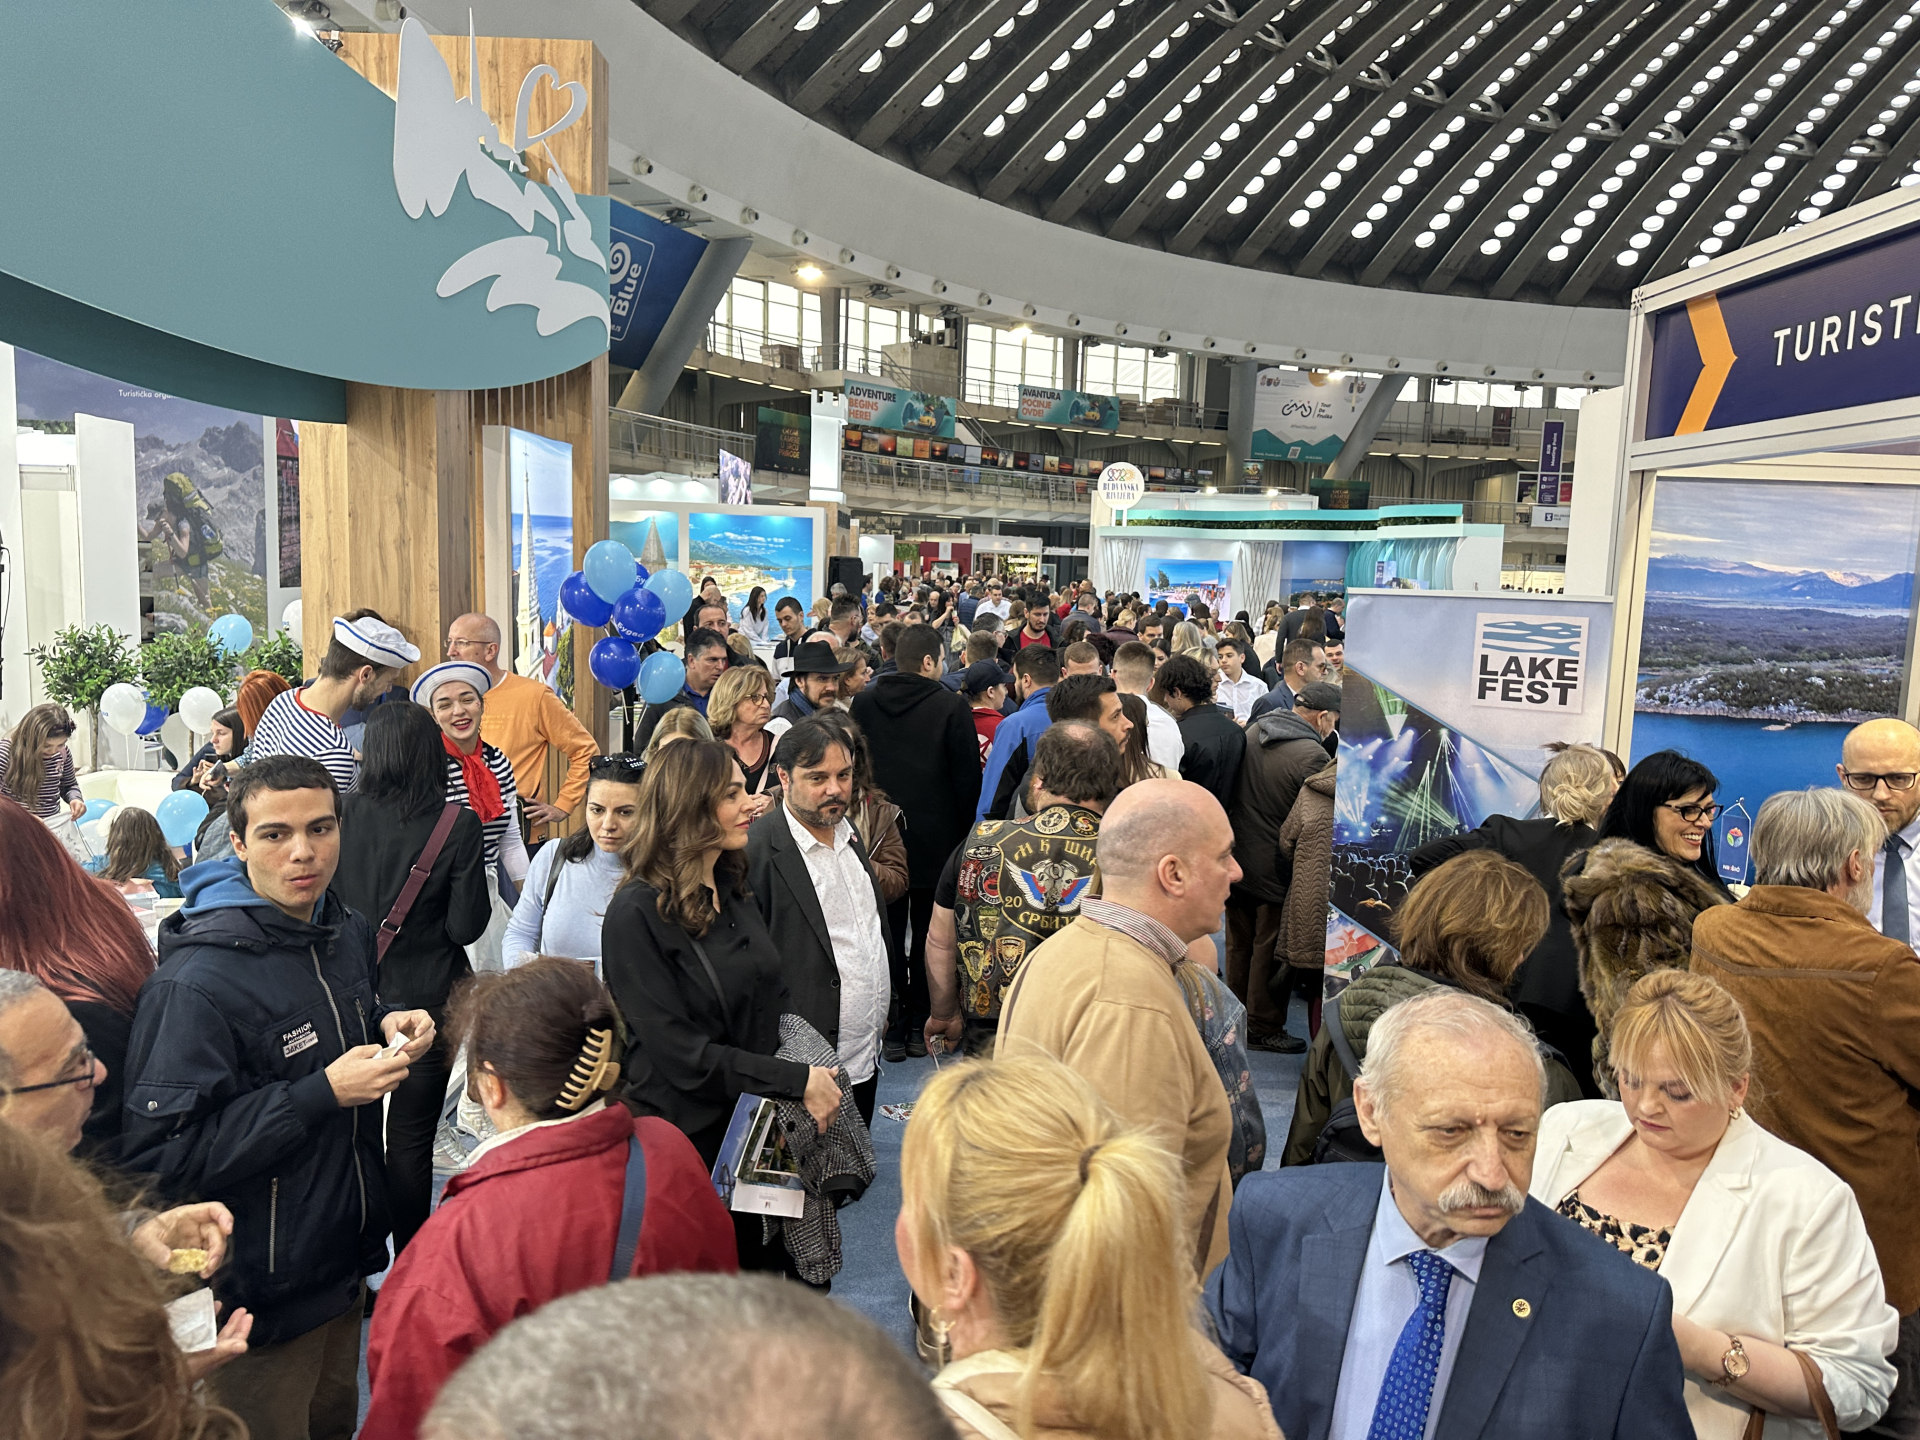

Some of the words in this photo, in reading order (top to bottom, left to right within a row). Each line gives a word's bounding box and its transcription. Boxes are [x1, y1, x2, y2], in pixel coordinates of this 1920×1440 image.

[613, 263, 642, 317] Blue
[118, 389, 153, 398] Turistička
[849, 385, 897, 403] ADVENTURE
[1022, 388, 1061, 401] AVANTURA
[848, 397, 879, 412] BEGINS
[848, 409, 872, 421] HERE!
[1022, 407, 1044, 418] OVDE!
[1103, 482, 1139, 491] BUDVANSKA
[1106, 491, 1135, 500] RIVIJERA
[1480, 654, 1579, 681] LAKE
[1478, 677, 1577, 706] FEST
[1004, 896, 1022, 908] 20
[1019, 911, 1077, 930] СРБИЈ
[282, 1021, 312, 1042] FASHION
